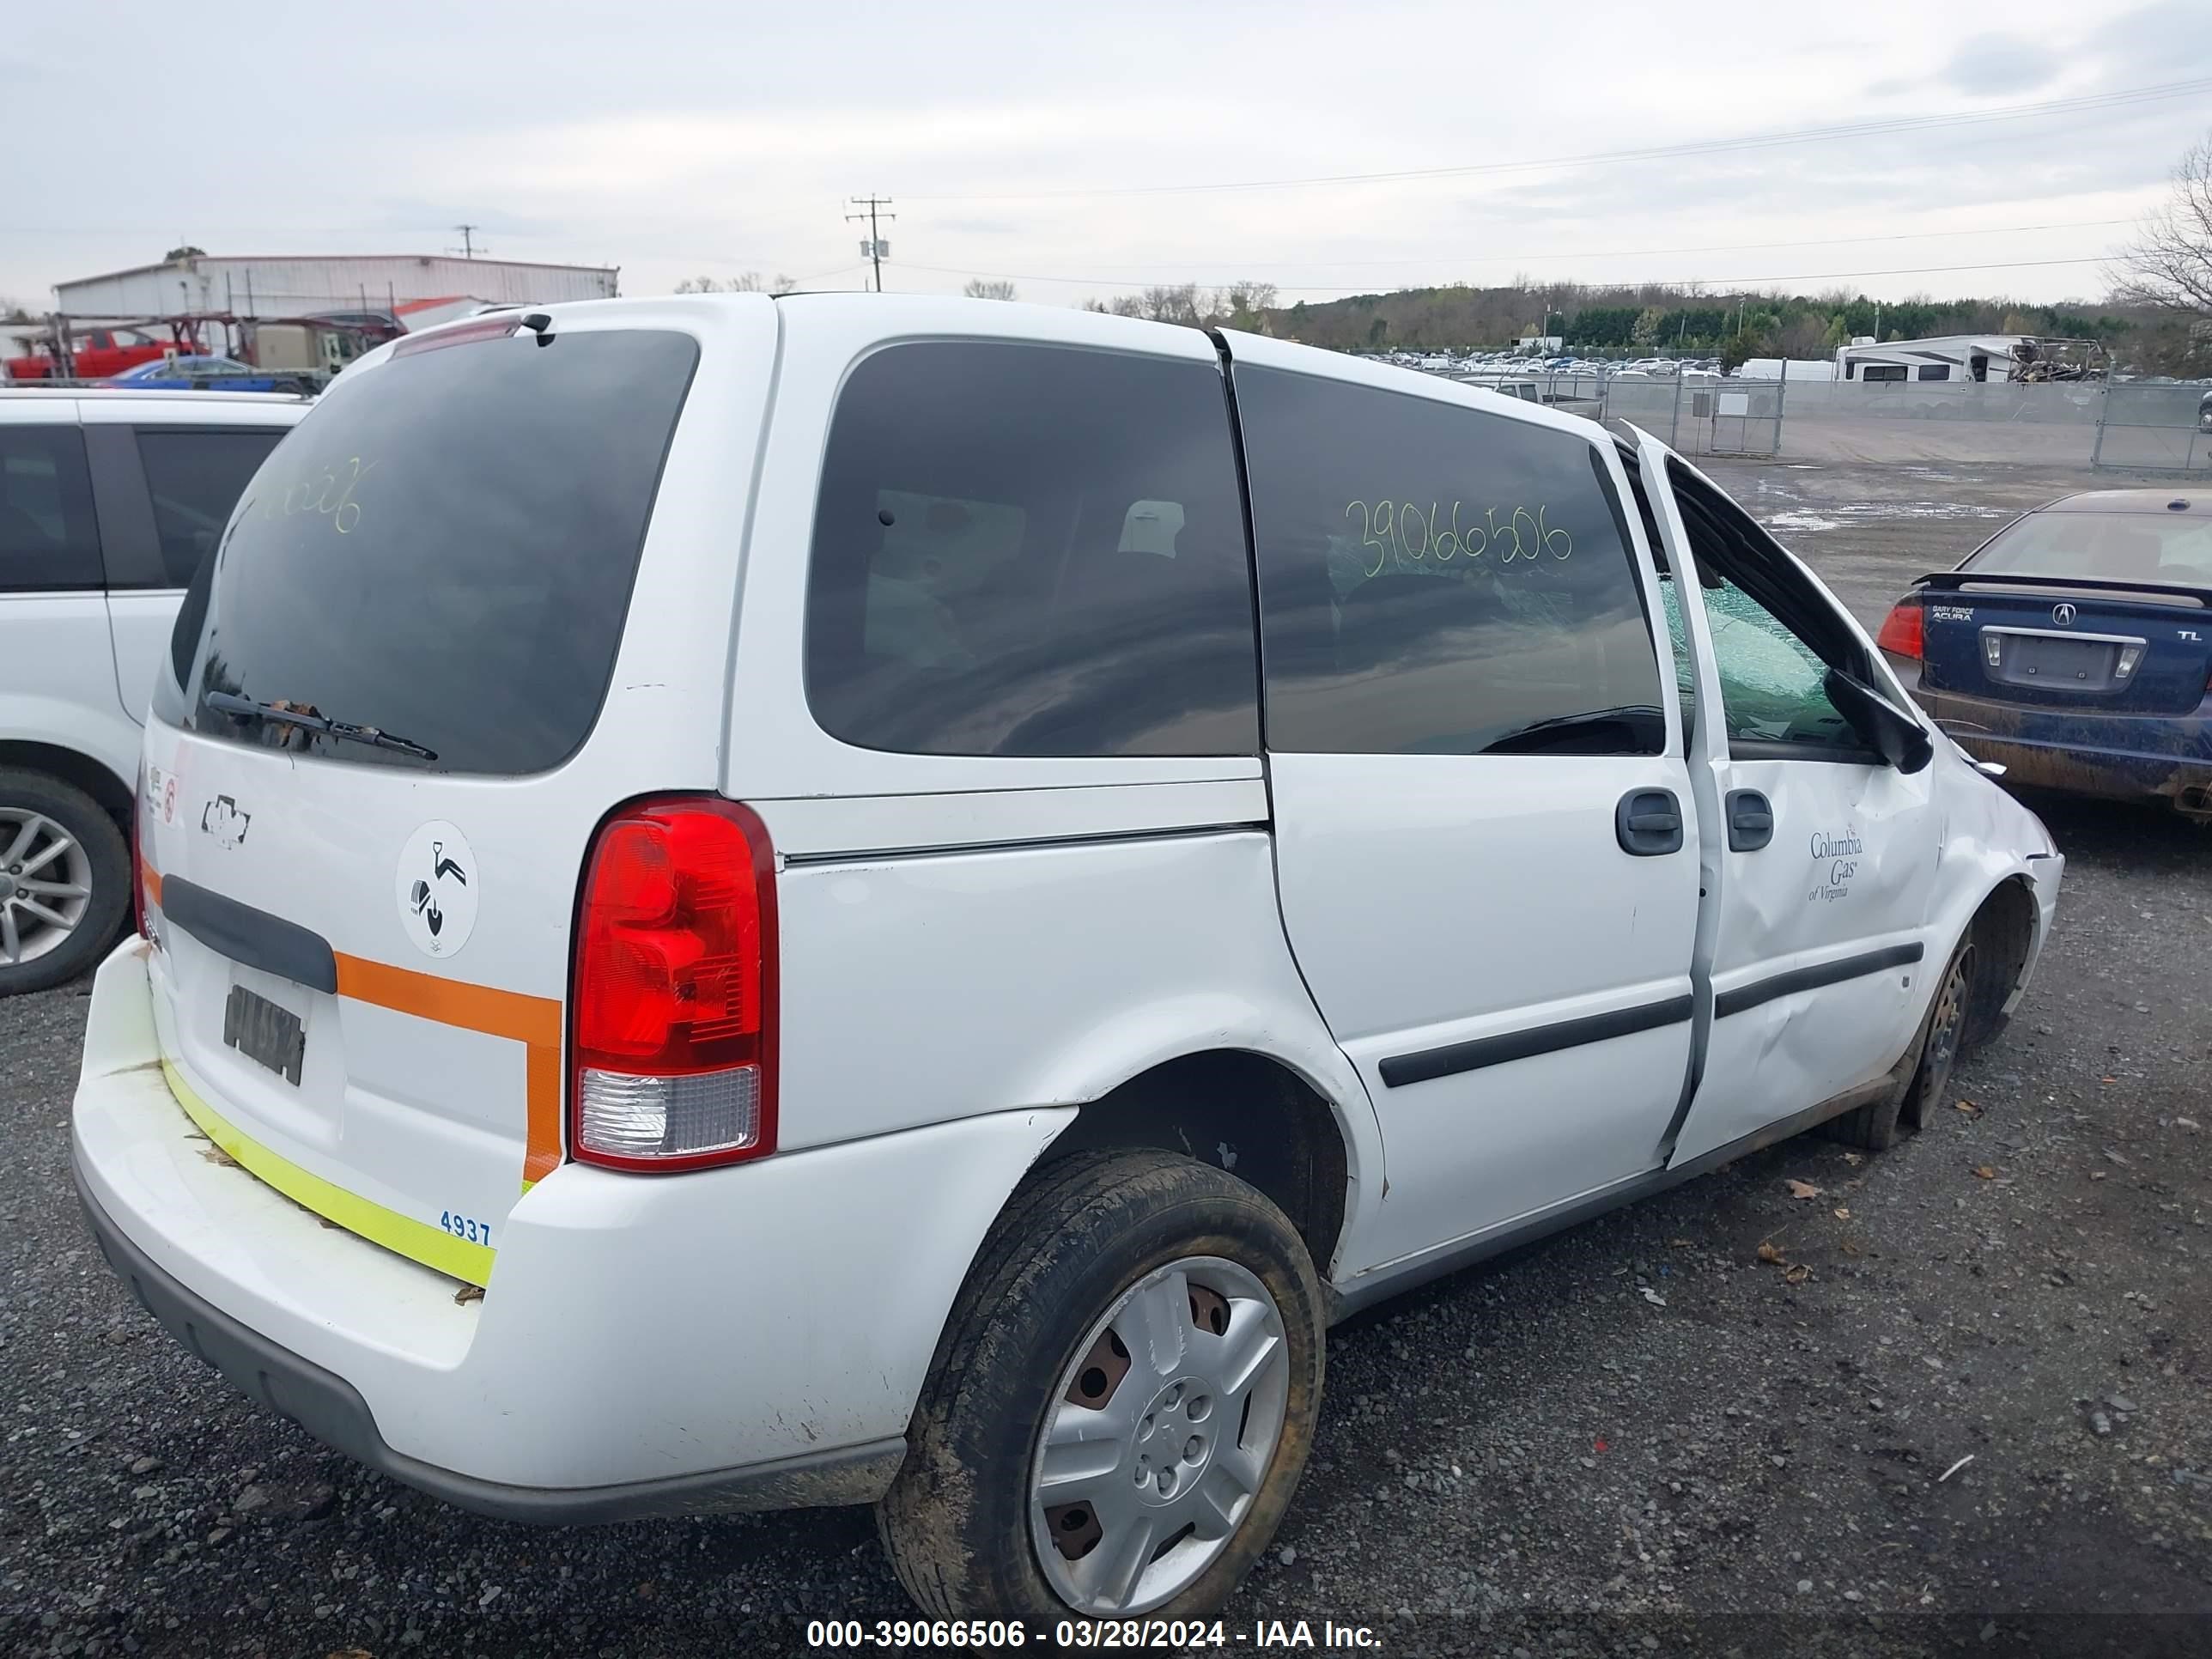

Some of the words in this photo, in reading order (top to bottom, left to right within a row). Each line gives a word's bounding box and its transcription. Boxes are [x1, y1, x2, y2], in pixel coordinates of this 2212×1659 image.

[1346, 500, 1572, 577] 39066506
[1932, 612, 1972, 622] ACURA
[2177, 630, 2203, 641] TL
[1811, 830, 1863, 859] Columbia
[1808, 886, 1819, 901] of
[1821, 884, 1848, 902] Virginia
[441, 1211, 489, 1246] 4937
